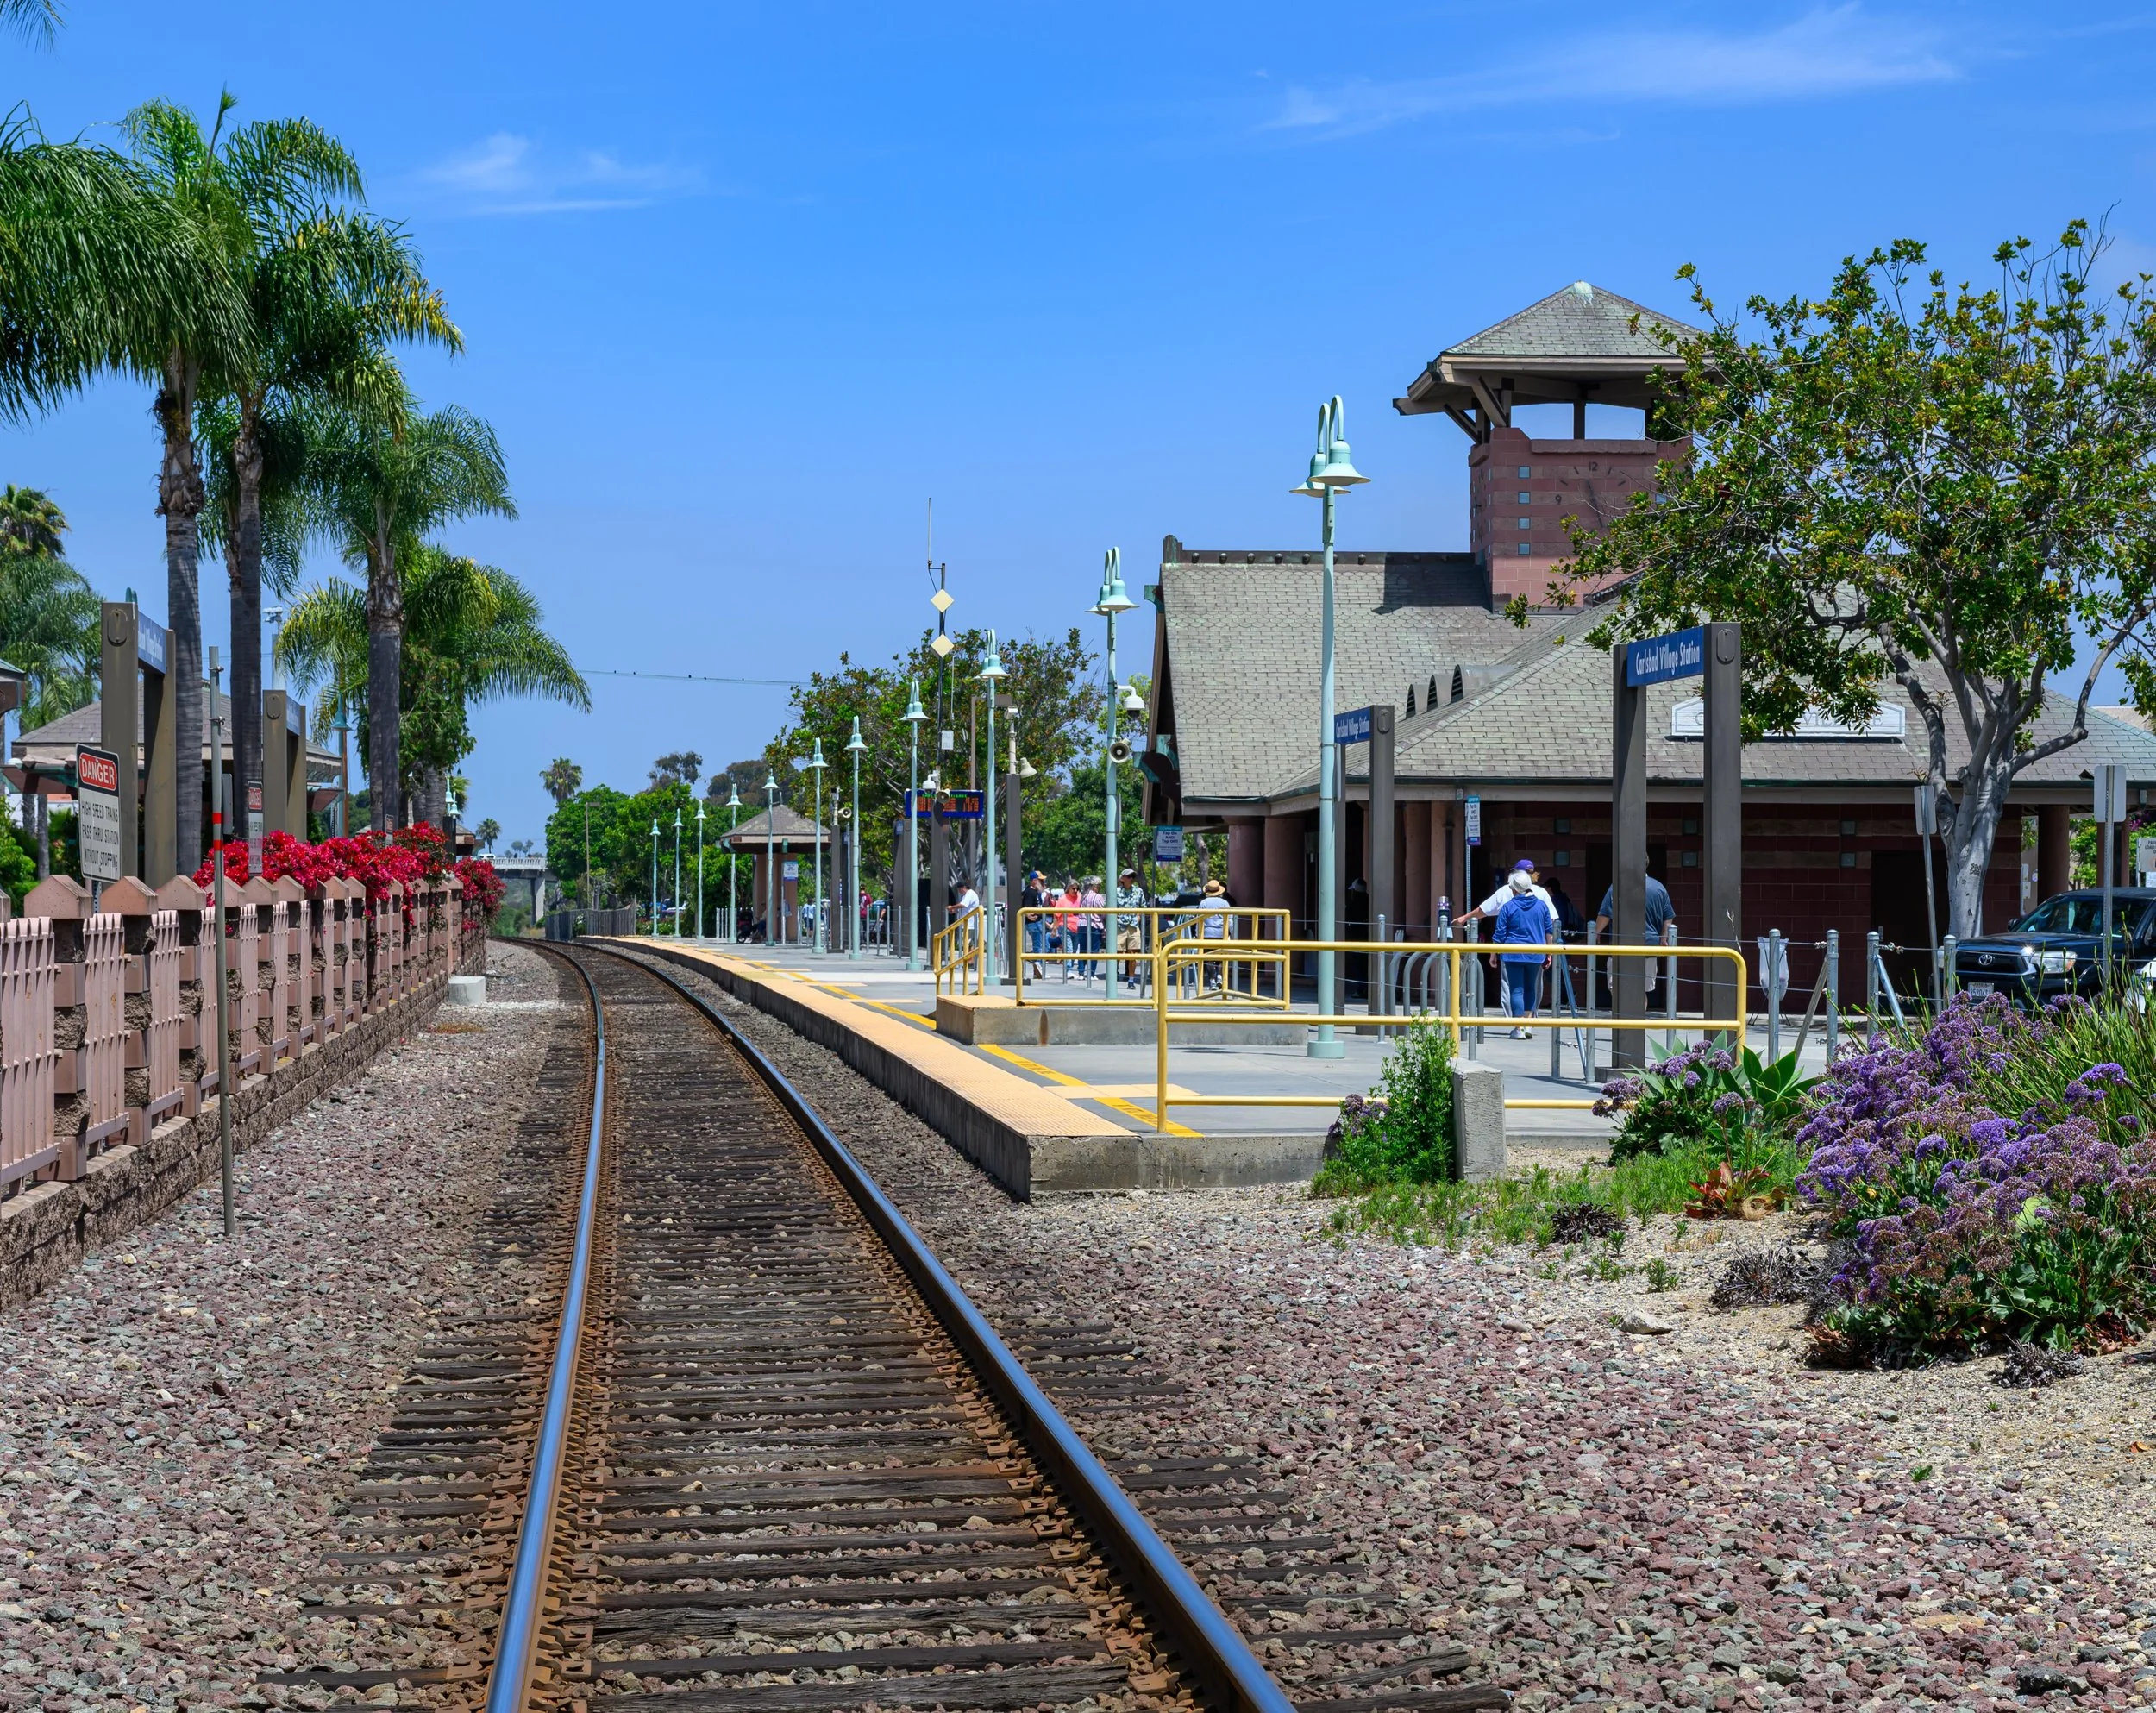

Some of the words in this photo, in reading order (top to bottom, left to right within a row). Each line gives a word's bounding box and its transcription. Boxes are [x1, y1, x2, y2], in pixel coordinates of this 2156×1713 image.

[1636, 646, 1658, 675] Carlsbad
[1659, 643, 1678, 675] Village
[1679, 640, 1701, 667] Station
[81, 758, 115, 785] DANGER
[81, 801, 91, 816] HIGH
[92, 803, 104, 819] SPEED
[105, 806, 118, 822] TRAINS
[82, 824, 91, 839] PASS
[92, 826, 103, 842] THRU
[104, 829, 119, 845] STATION
[84, 848, 98, 864] WITHOUT
[100, 851, 118, 867] STOPPING
